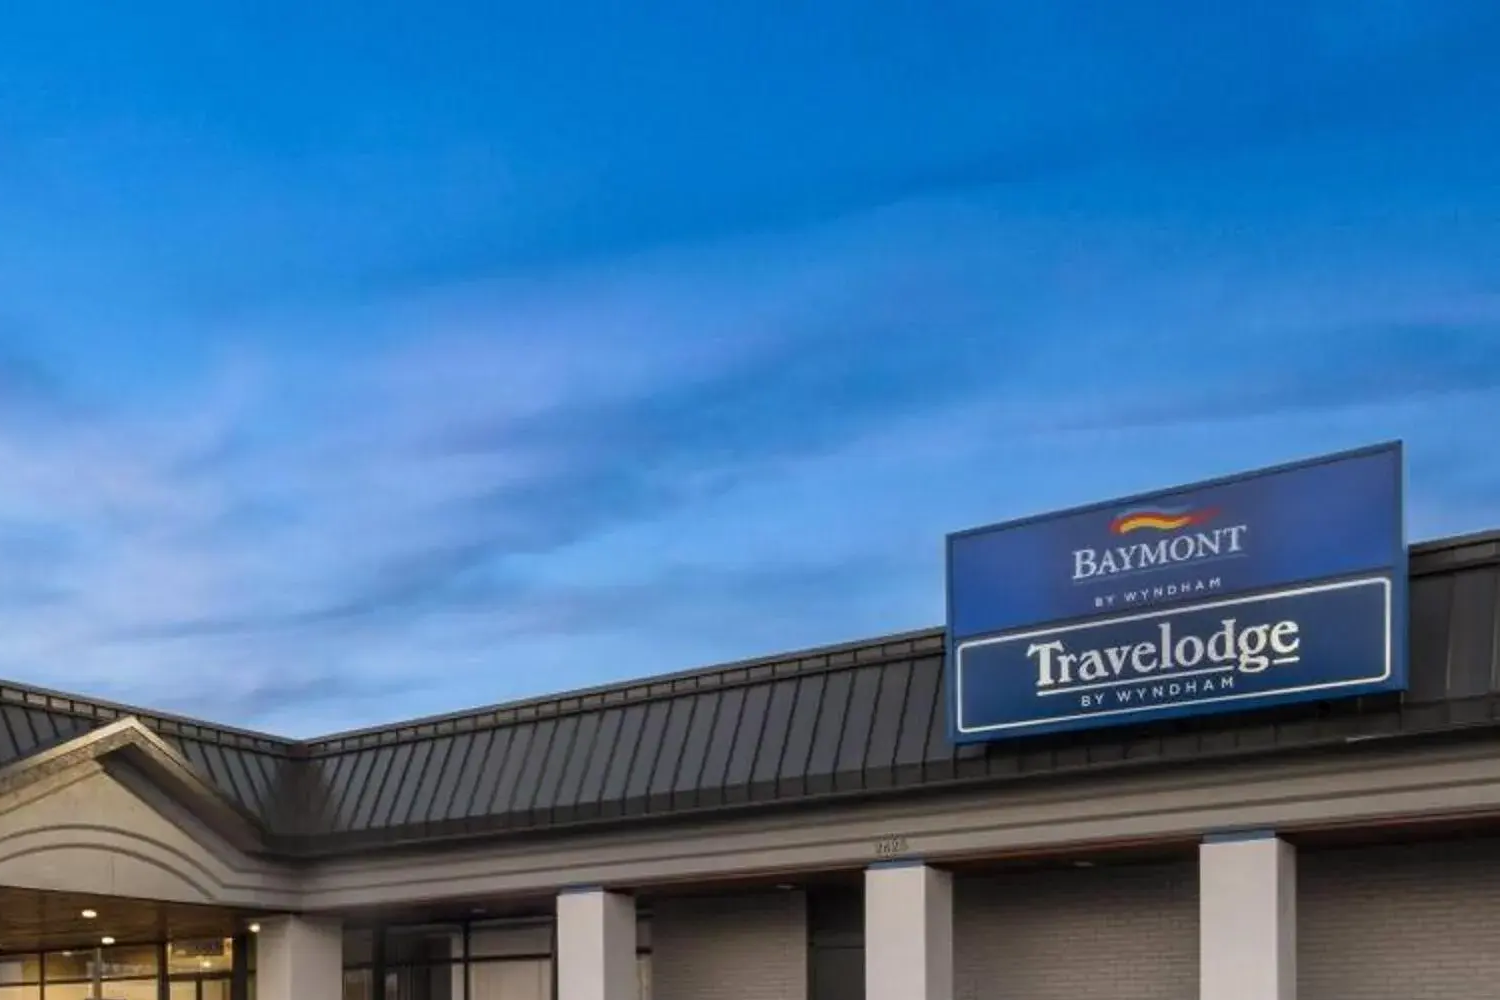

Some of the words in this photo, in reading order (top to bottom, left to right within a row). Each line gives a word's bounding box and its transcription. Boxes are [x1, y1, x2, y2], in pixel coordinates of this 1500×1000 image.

[1072, 525, 1247, 580] BAYMONT
[1095, 595, 1115, 608] BY
[1124, 576, 1221, 602] WYNDHAM
[1027, 618, 1299, 686] Travelodge
[1081, 694, 1104, 707] BY
[1116, 676, 1235, 702] WYNDHAM
